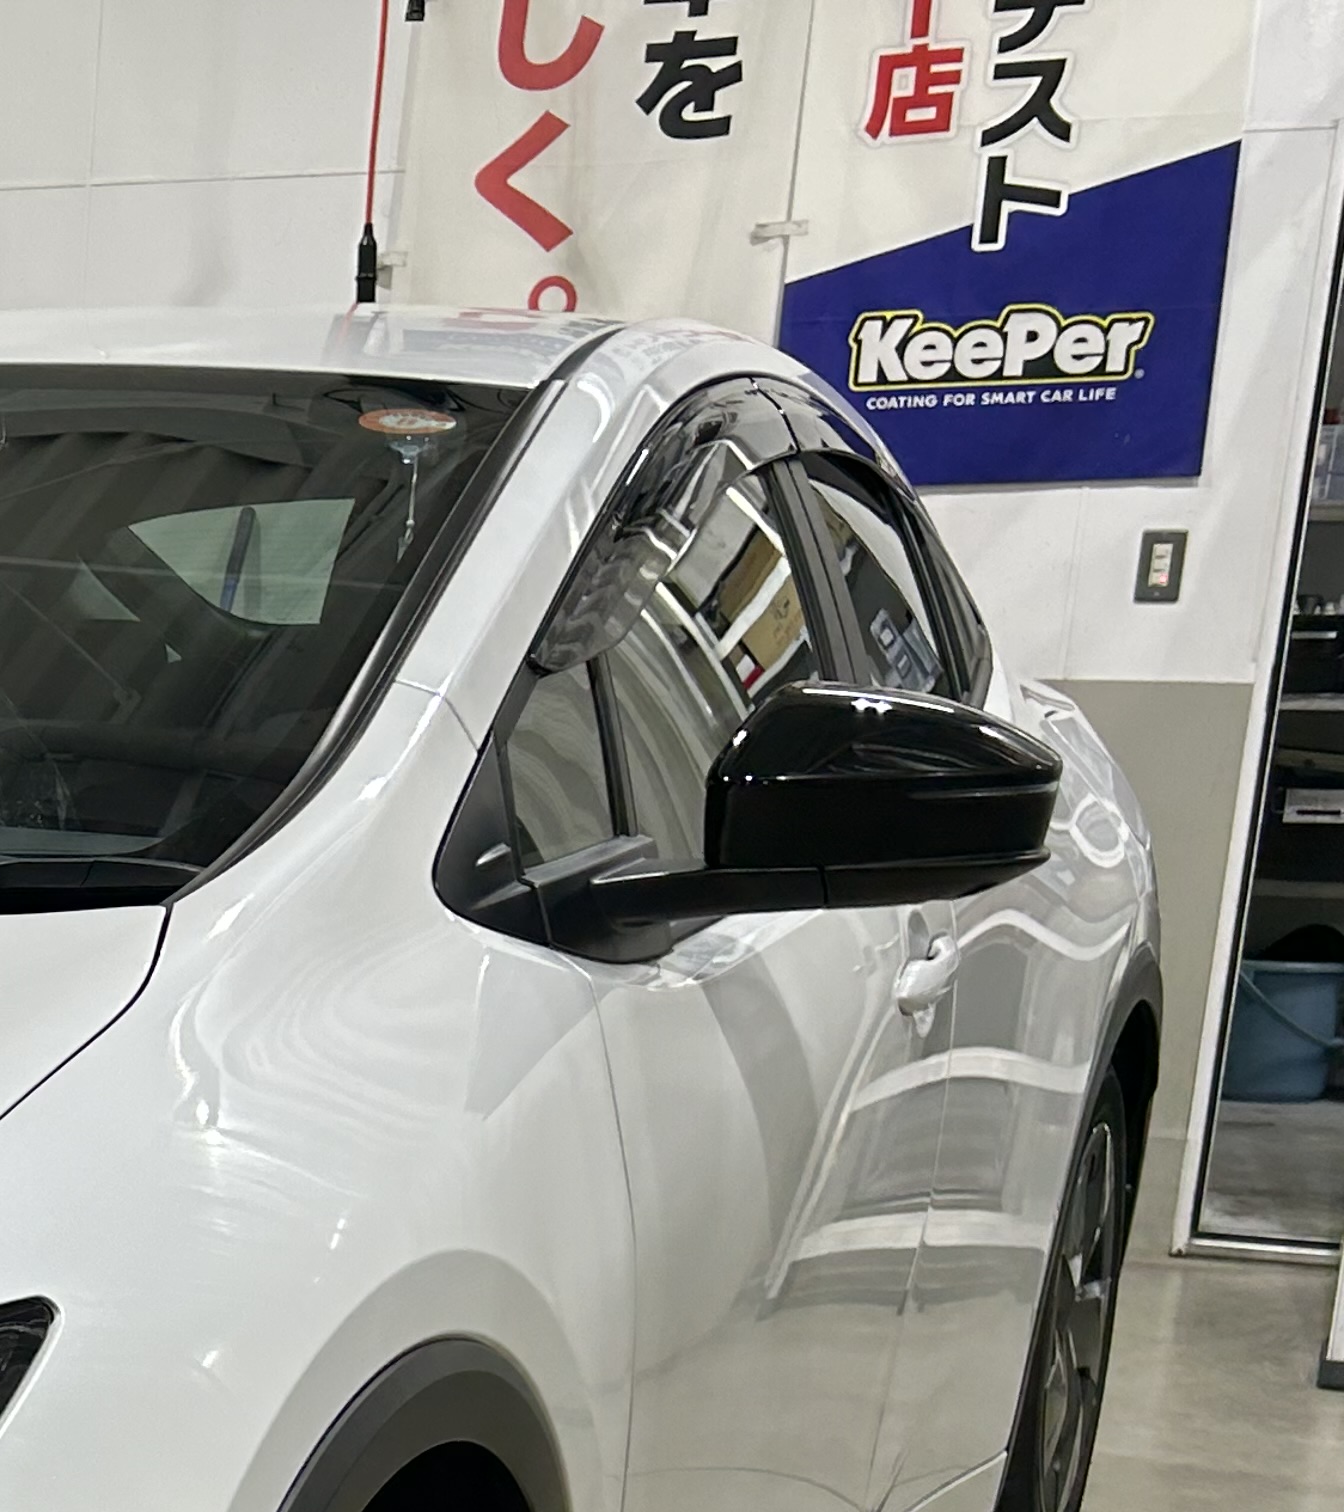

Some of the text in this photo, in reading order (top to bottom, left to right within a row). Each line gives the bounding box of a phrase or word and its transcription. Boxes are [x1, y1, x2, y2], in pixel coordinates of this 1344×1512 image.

[636, 0, 743, 140] を
[852, 305, 1152, 390] KeePer
[865, 387, 1117, 411] COATING FOR SMART CAR LIFE
